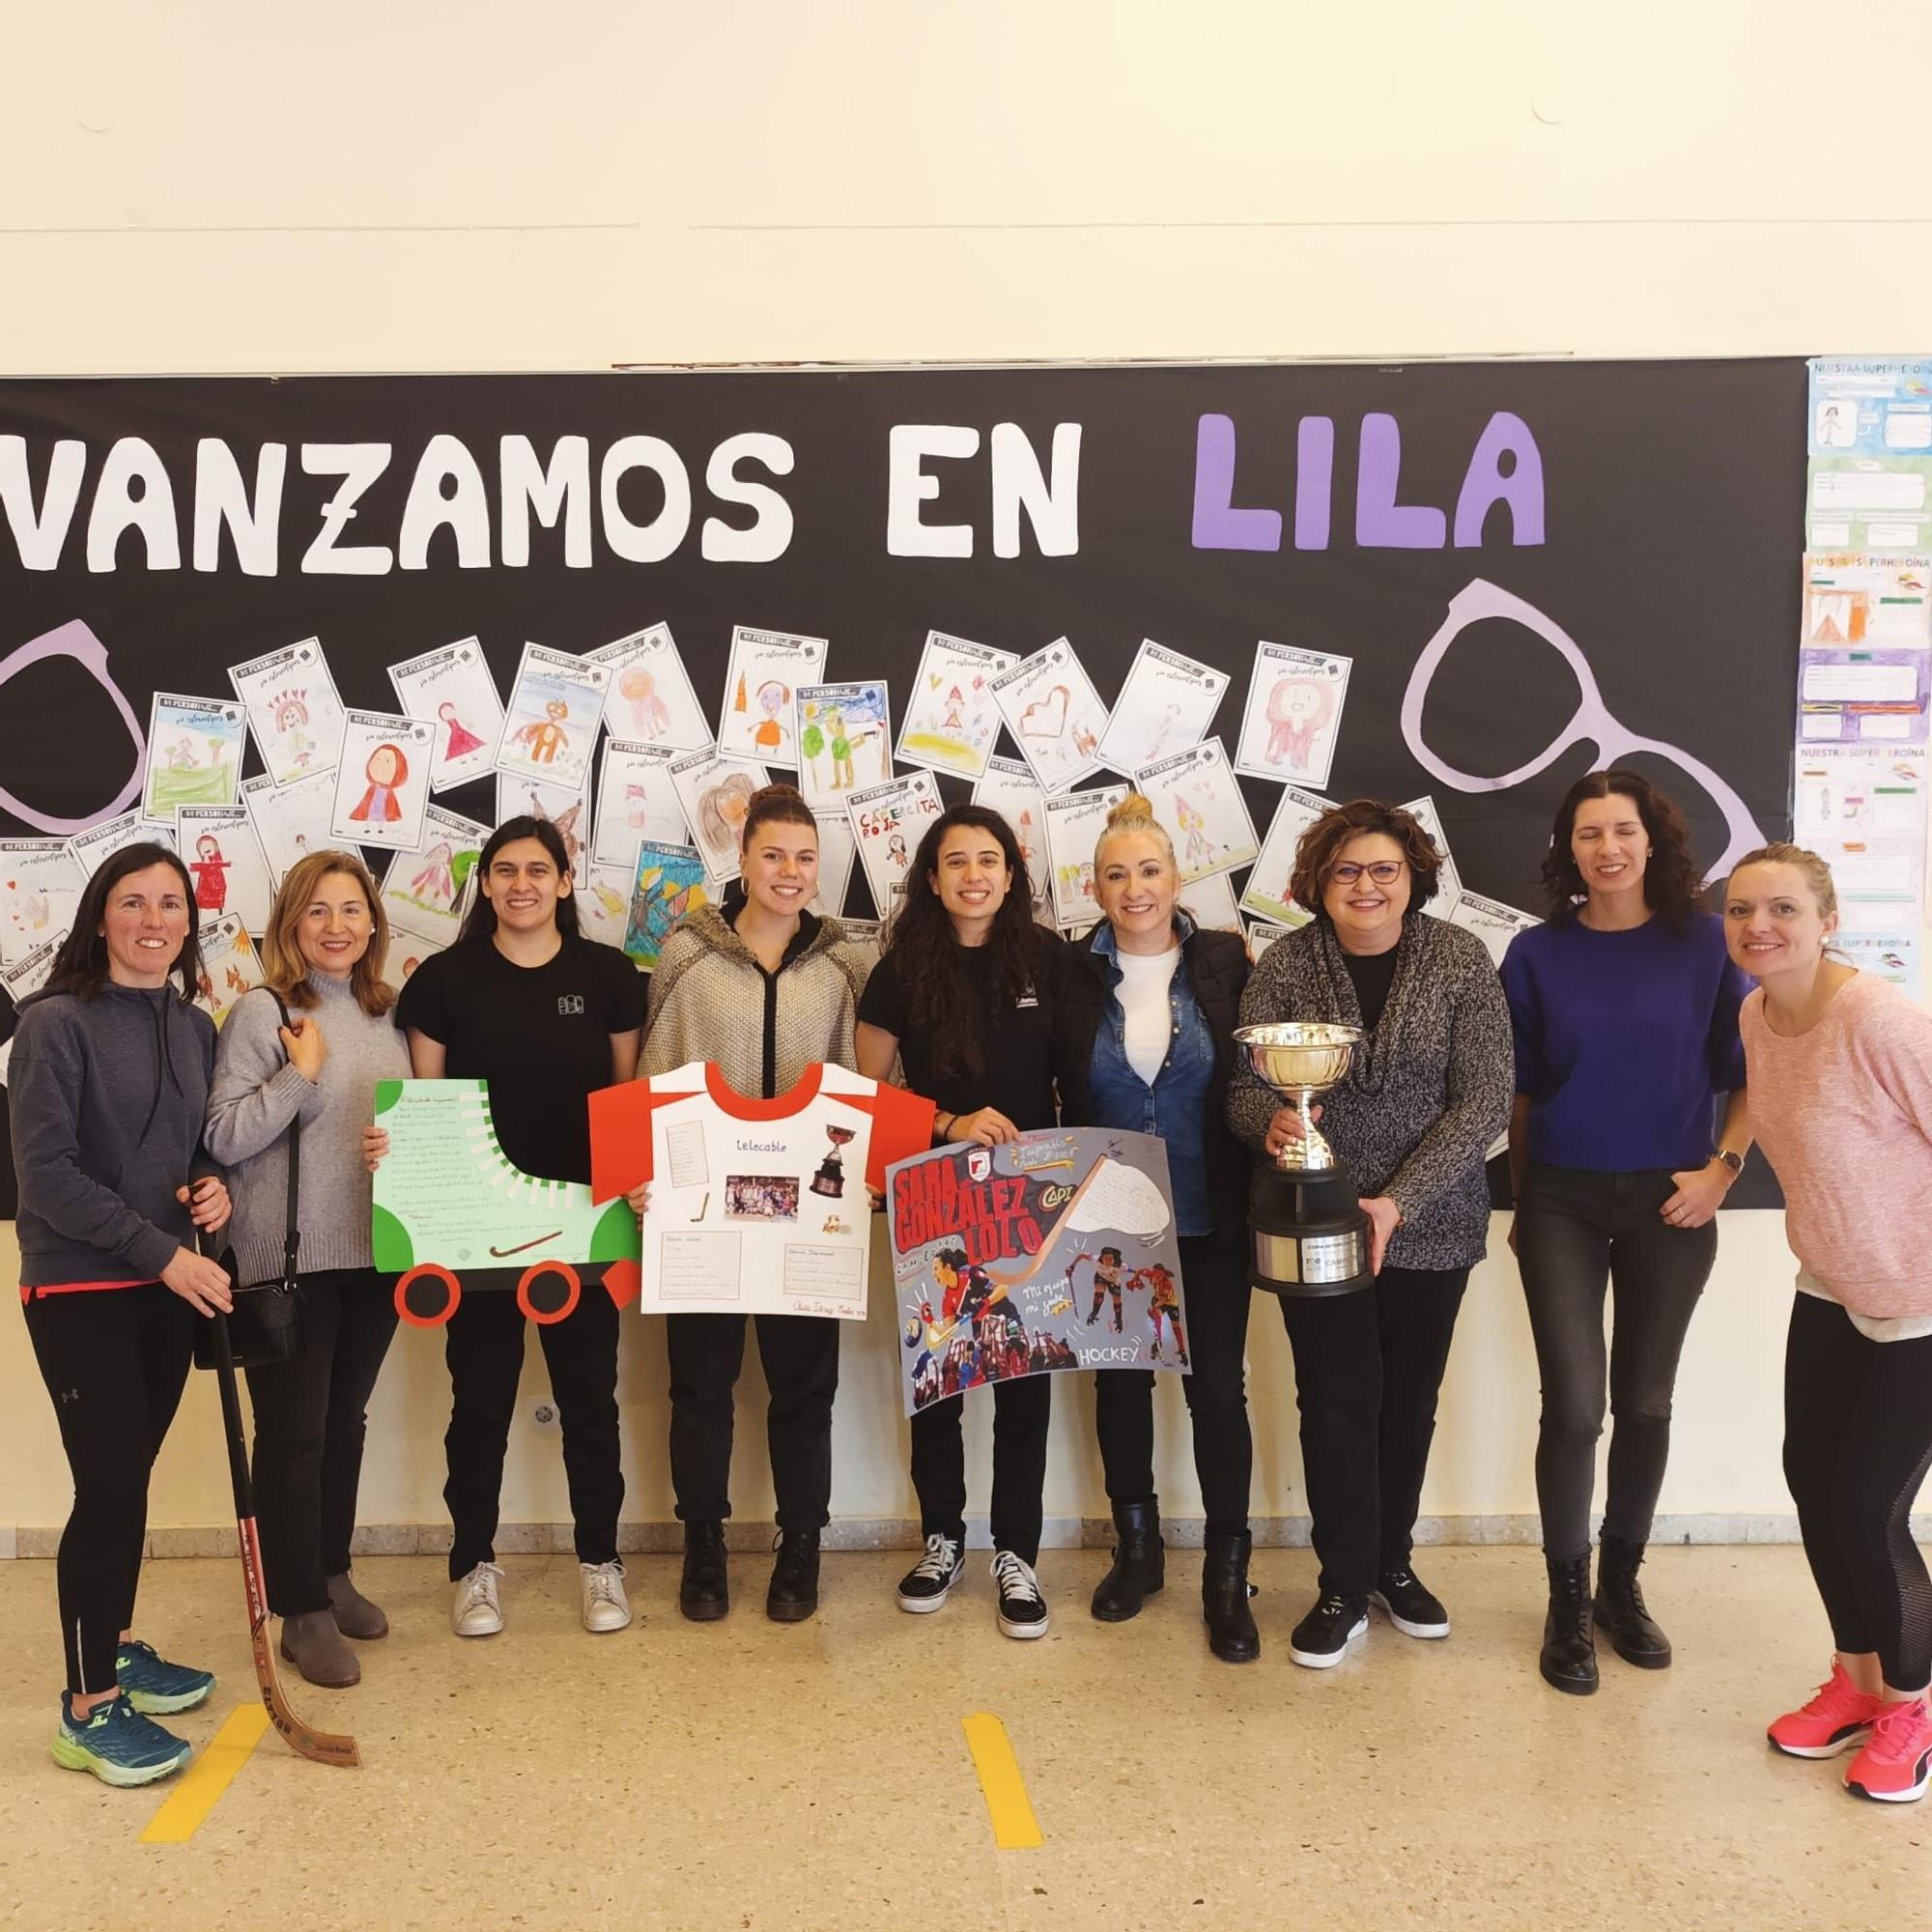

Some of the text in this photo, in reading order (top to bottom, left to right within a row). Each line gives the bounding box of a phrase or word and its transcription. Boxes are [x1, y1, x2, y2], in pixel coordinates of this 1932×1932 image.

[887, 422, 1082, 558] EN
[1192, 412, 1546, 552] LILA
[862, 817, 900, 838] ROJA
[736, 1140, 787, 1152] telecable
[895, 1156, 959, 1209] SARA
[1042, 1184, 1074, 1208] CAPI
[966, 1216, 1043, 1265] LOLO
[1023, 1286, 1041, 1299] Mi
[1026, 1301, 1039, 1315] mi
[1078, 1347, 1140, 1366] HOCKEY
